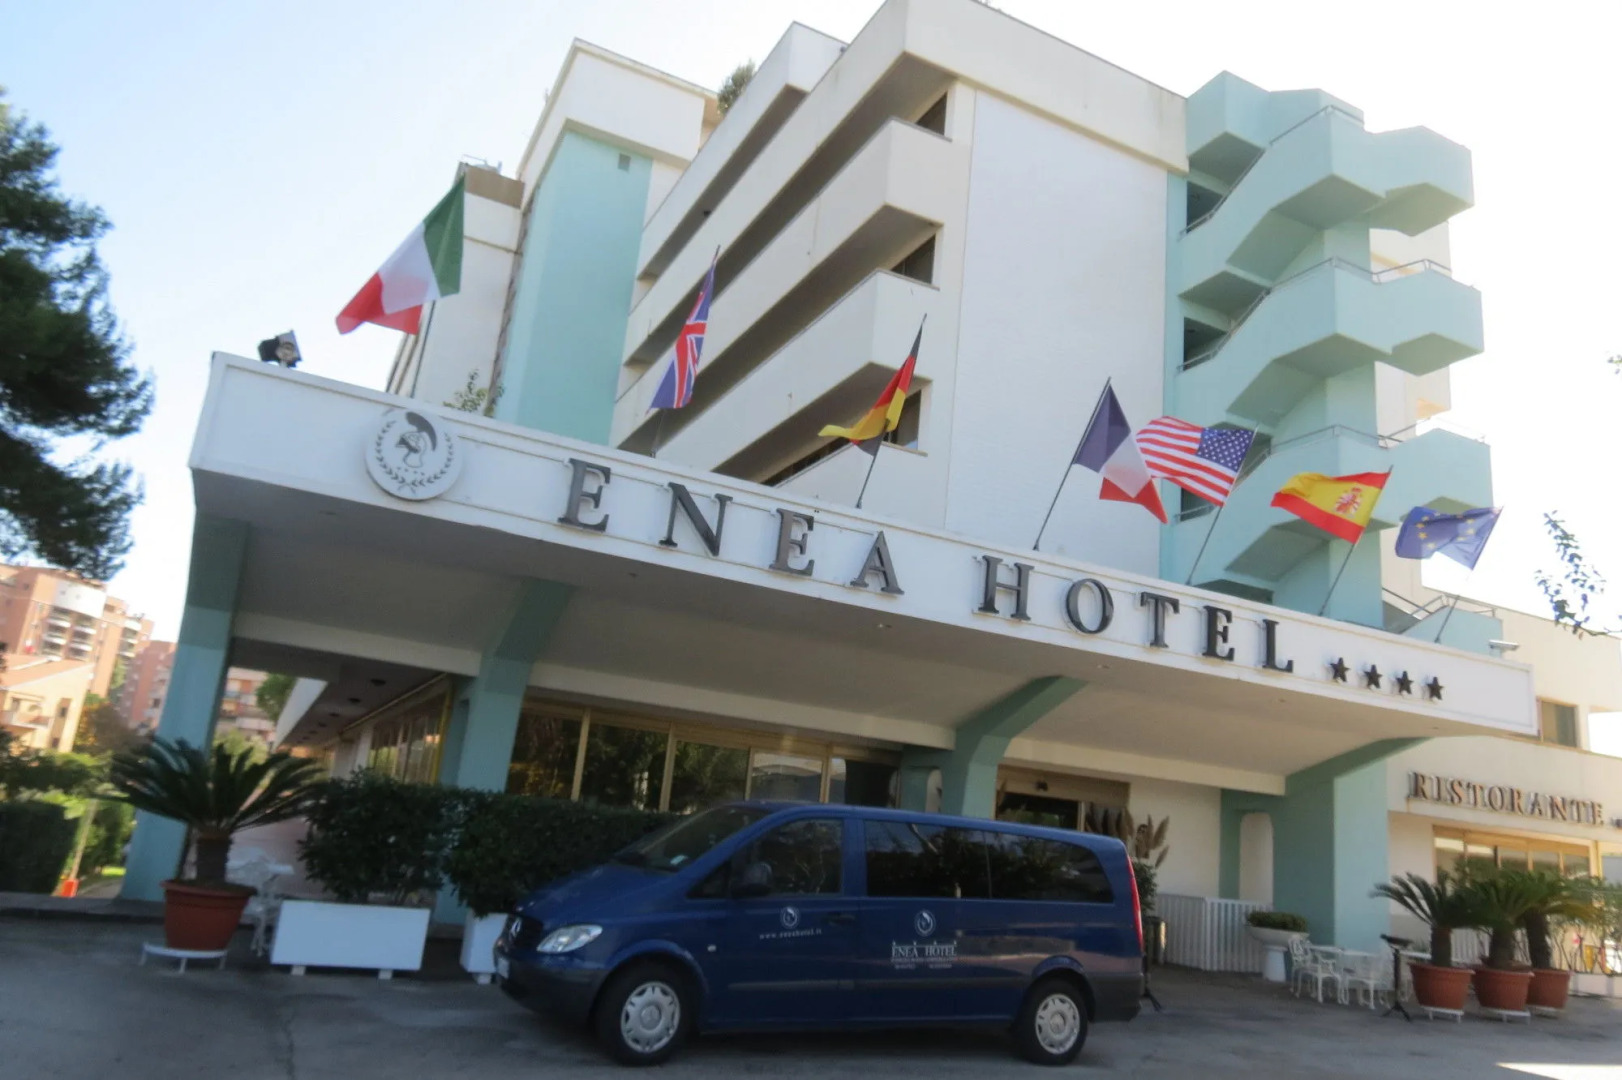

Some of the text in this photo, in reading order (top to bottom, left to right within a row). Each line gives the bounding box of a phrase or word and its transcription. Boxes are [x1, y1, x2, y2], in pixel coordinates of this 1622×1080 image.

[559, 457, 1294, 674] ENEA HOTEL
[1407, 771, 1604, 826] RISTORANTE
[891, 944, 957, 958] ENEA HOTEL
